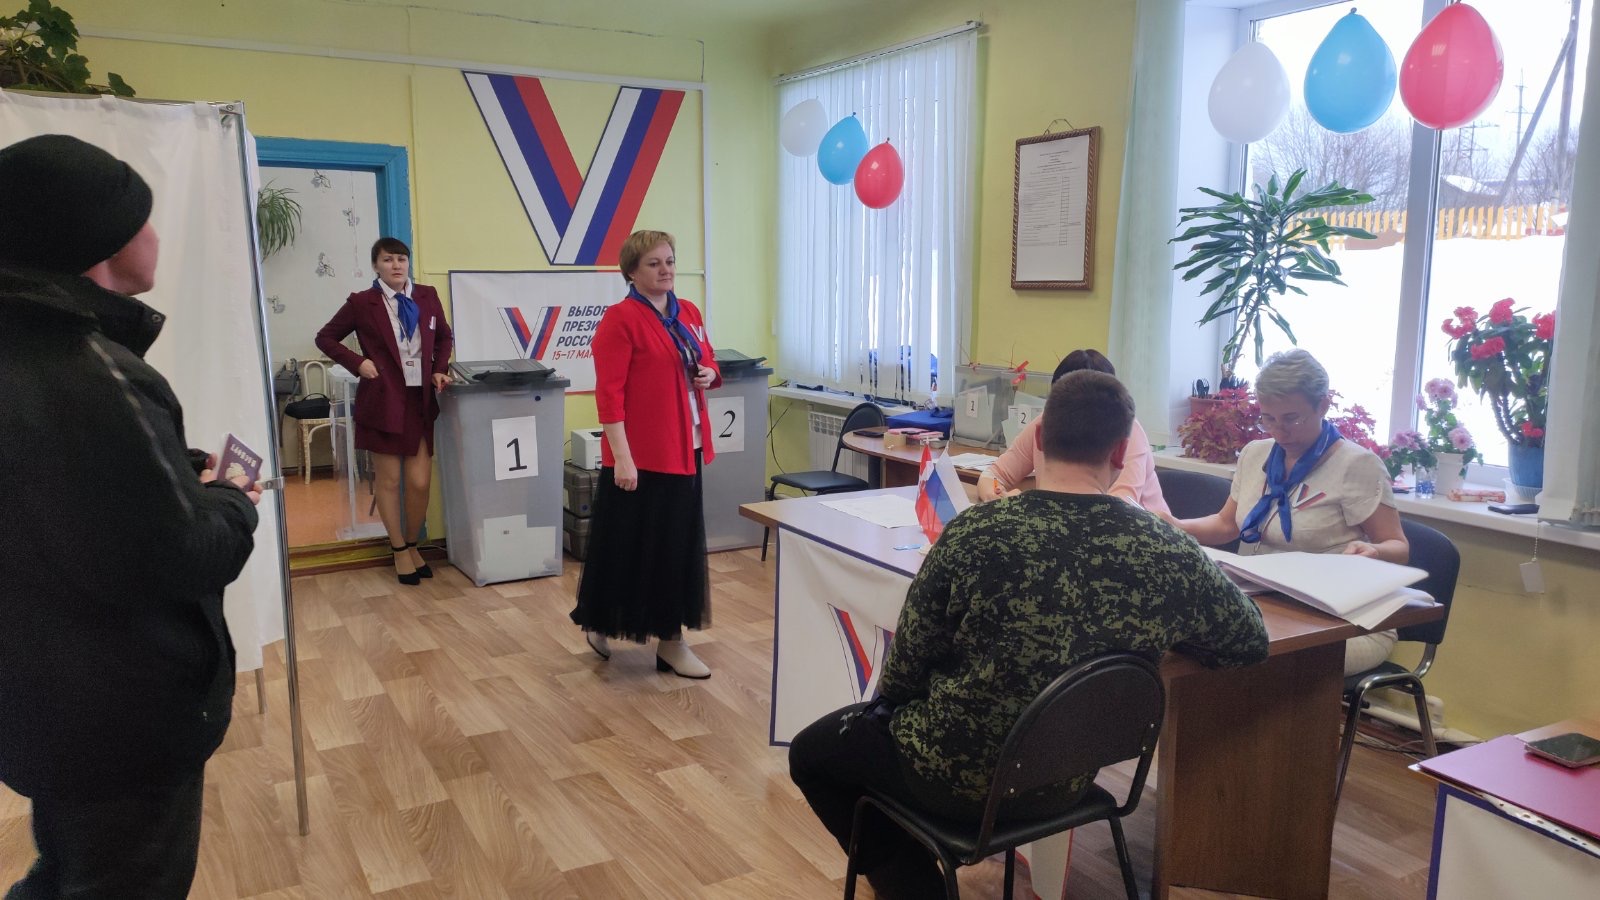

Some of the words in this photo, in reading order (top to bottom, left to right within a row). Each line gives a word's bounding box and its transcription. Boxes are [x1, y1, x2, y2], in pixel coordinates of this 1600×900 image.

[719, 409, 736, 438] 2
[1020, 412, 1027, 425] 2
[506, 438, 528, 471] 1
